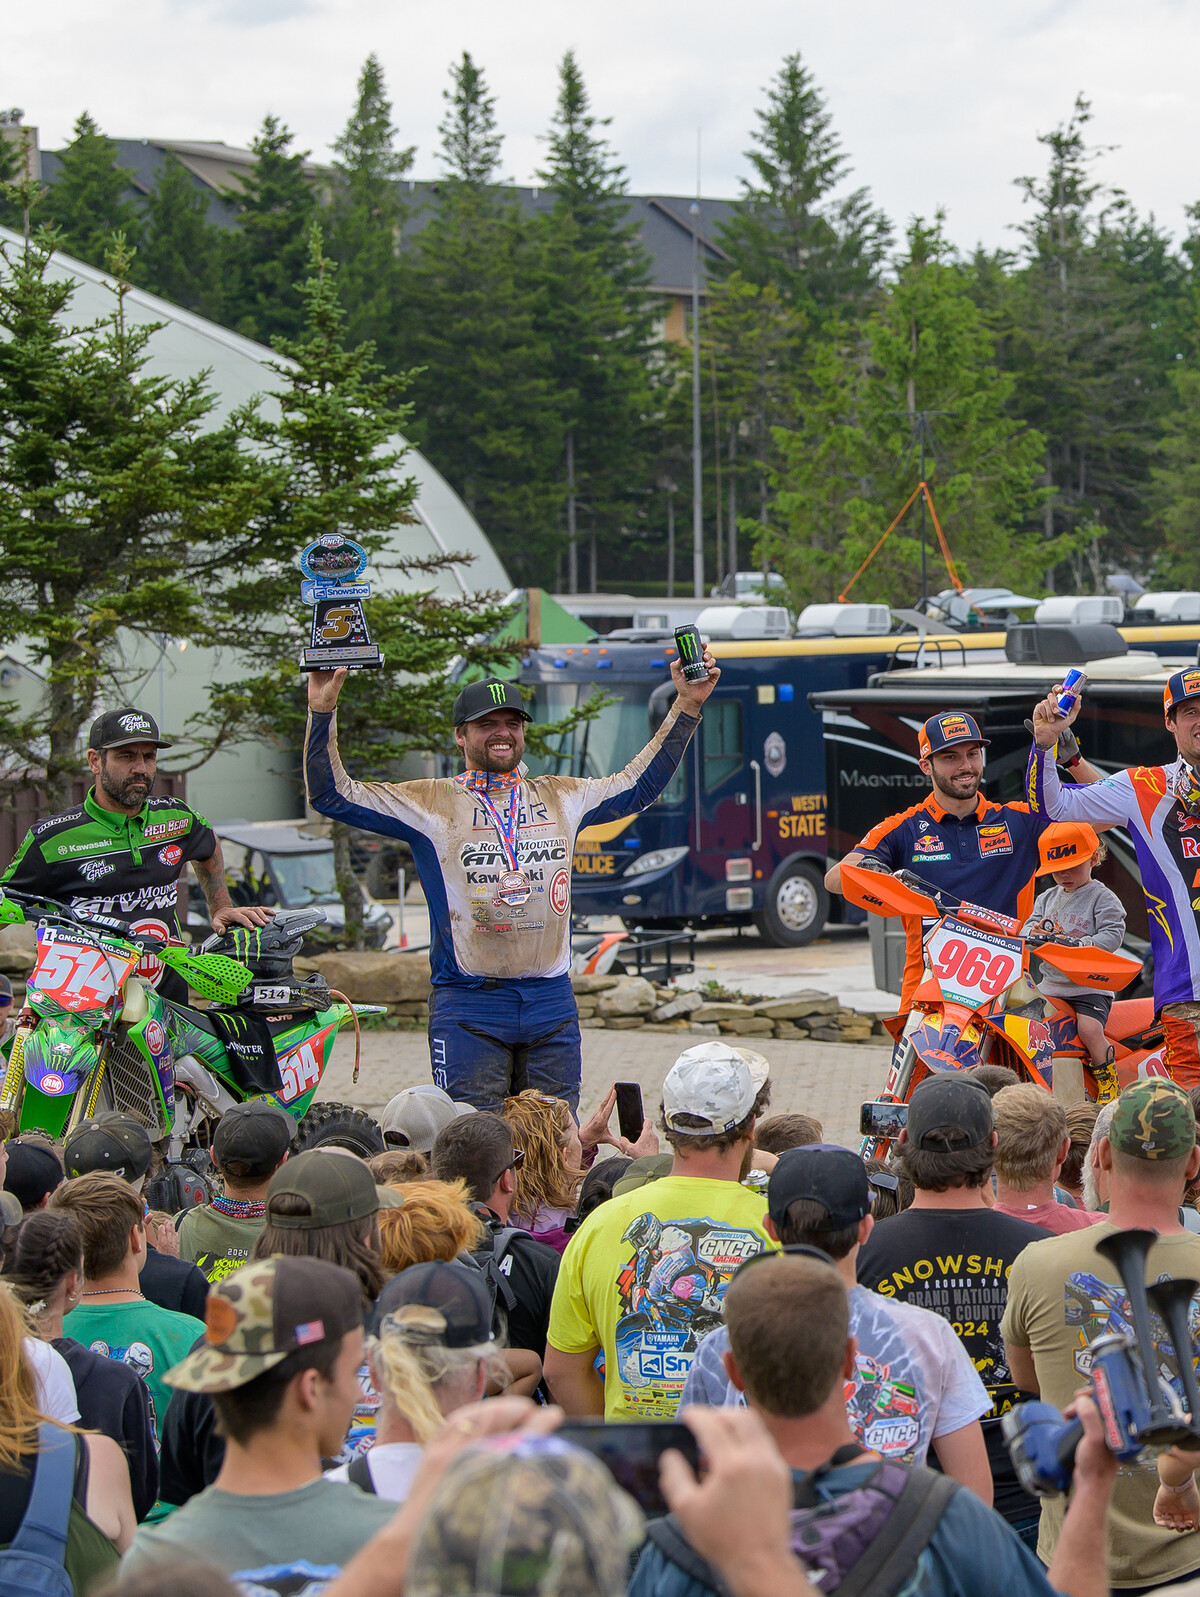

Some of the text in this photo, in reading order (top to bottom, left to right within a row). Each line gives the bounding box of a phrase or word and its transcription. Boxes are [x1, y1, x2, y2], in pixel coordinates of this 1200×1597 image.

[327, 587, 369, 596] Snowshoe
[947, 726, 967, 736] KTM
[791, 795, 821, 812] WEST
[167, 817, 190, 833] BEAR
[778, 814, 826, 839] STATE
[68, 838, 113, 853] Kawasaki
[984, 837, 1007, 848] KTM
[1047, 842, 1078, 861] KTM
[79, 860, 105, 874] TEAM
[573, 855, 615, 875] POLICE
[87, 864, 115, 882] GREEN
[861, 894, 884, 908] KTM
[955, 925, 1021, 951] GNCCRACING.COM
[34, 943, 129, 1003] 514
[934, 938, 1015, 996] 969
[1086, 973, 1111, 982] KTM
[259, 989, 286, 1000] 514
[952, 994, 979, 1008] MOTOREX
[282, 1042, 321, 1102] 514
[228, 1248, 248, 1257] 2024
[700, 1239, 759, 1257] GNCC
[712, 1256, 744, 1264] RACING
[935, 1278, 986, 1288] ROUND 9
[953, 1288, 1008, 1304] NATIONA
[952, 1321, 989, 1337] 024
[653, 1333, 680, 1343] YAMAHA
[868, 1425, 918, 1445] GNCC
[881, 1440, 908, 1450] RACING
